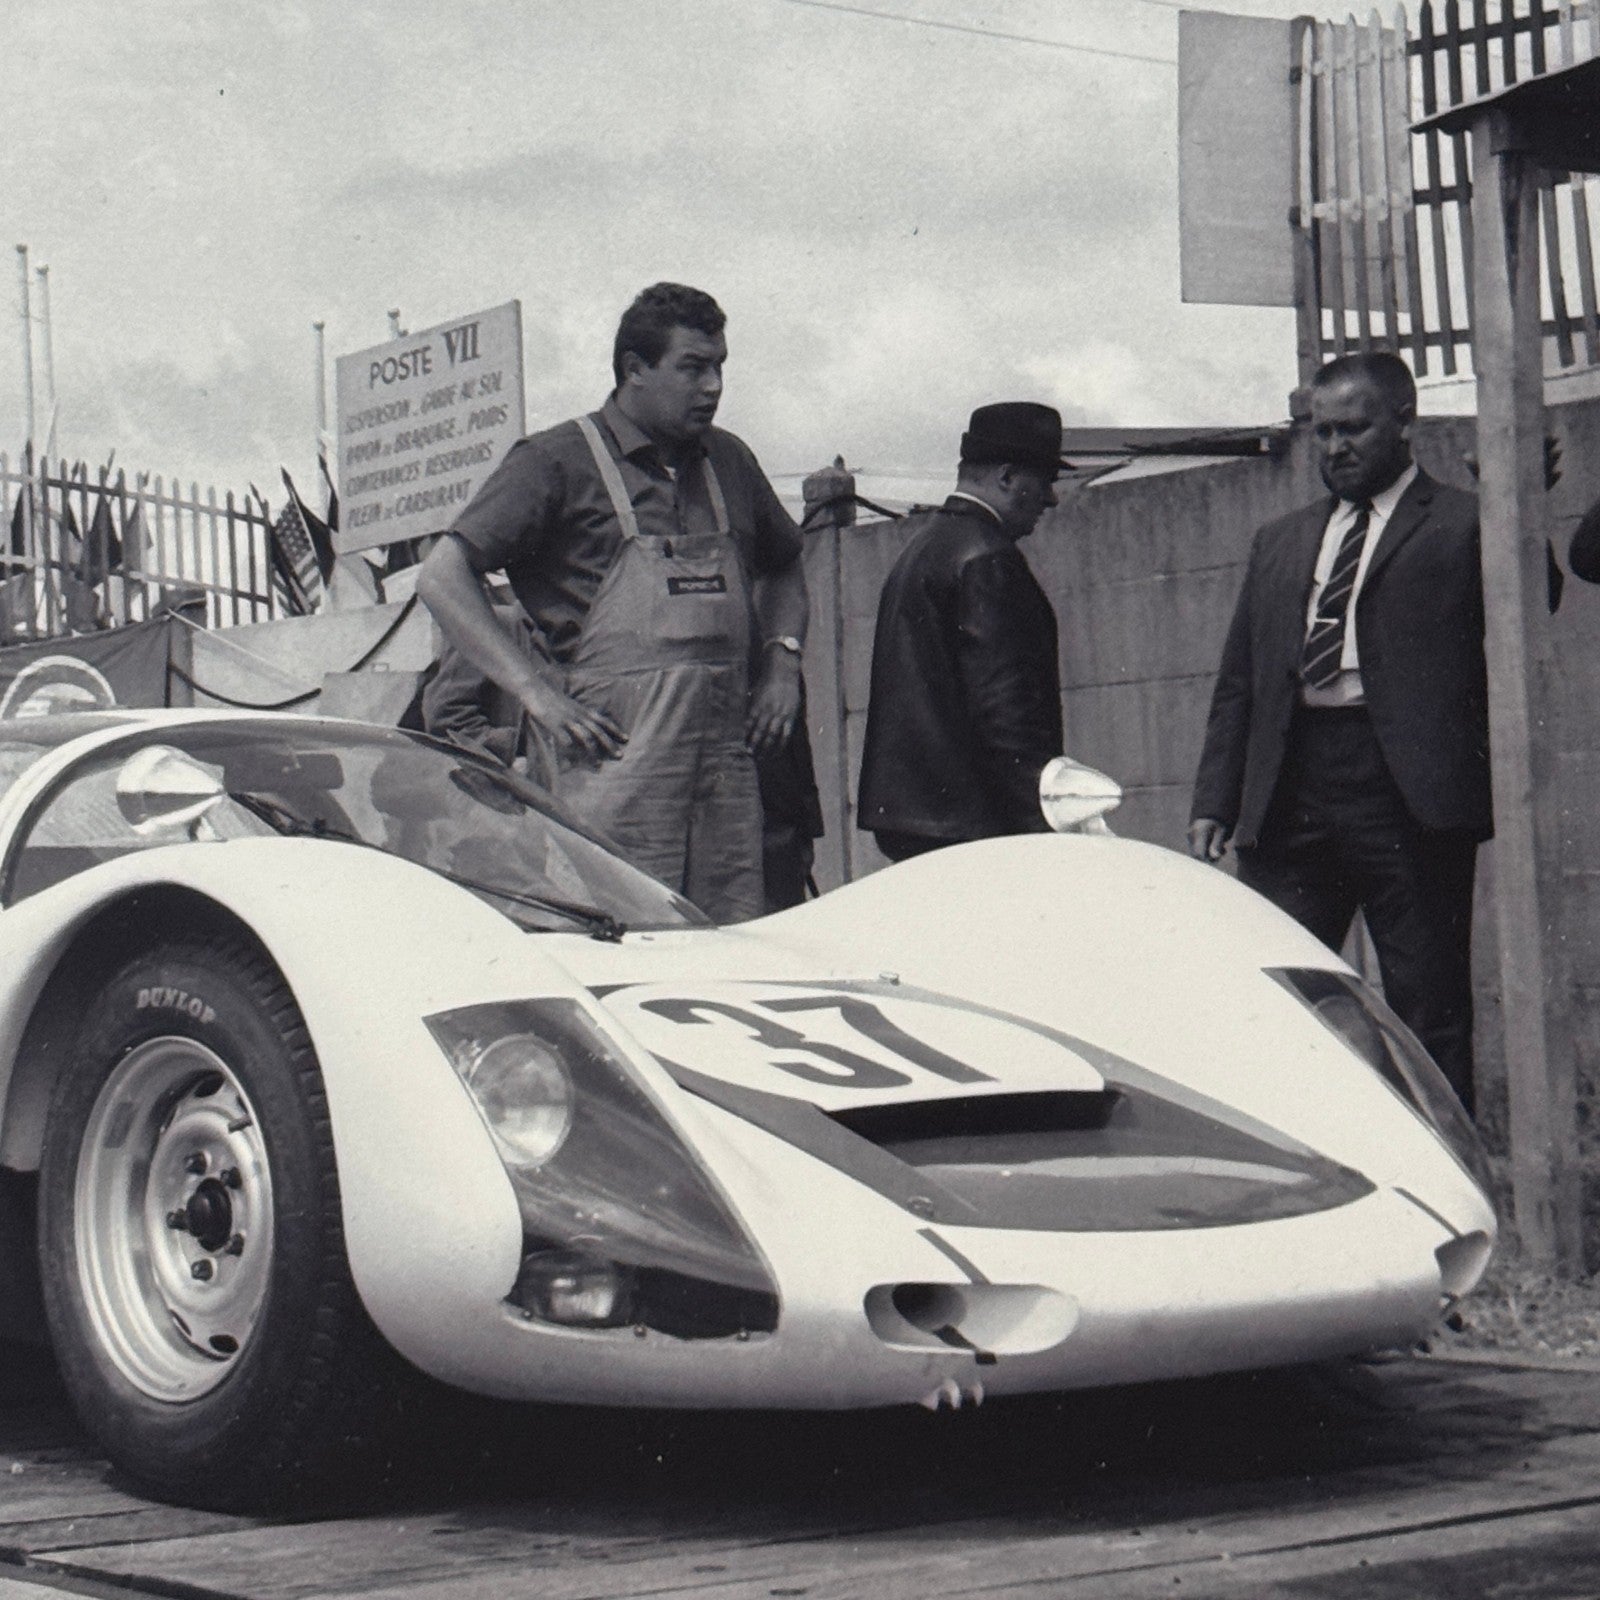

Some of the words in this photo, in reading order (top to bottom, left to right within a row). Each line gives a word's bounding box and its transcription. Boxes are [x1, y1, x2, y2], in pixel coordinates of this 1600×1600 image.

[369, 345, 432, 389] POSTE
[441, 321, 482, 368] VII
[137, 986, 216, 1023] DUNLOP
[639, 995, 1001, 1089] 37
